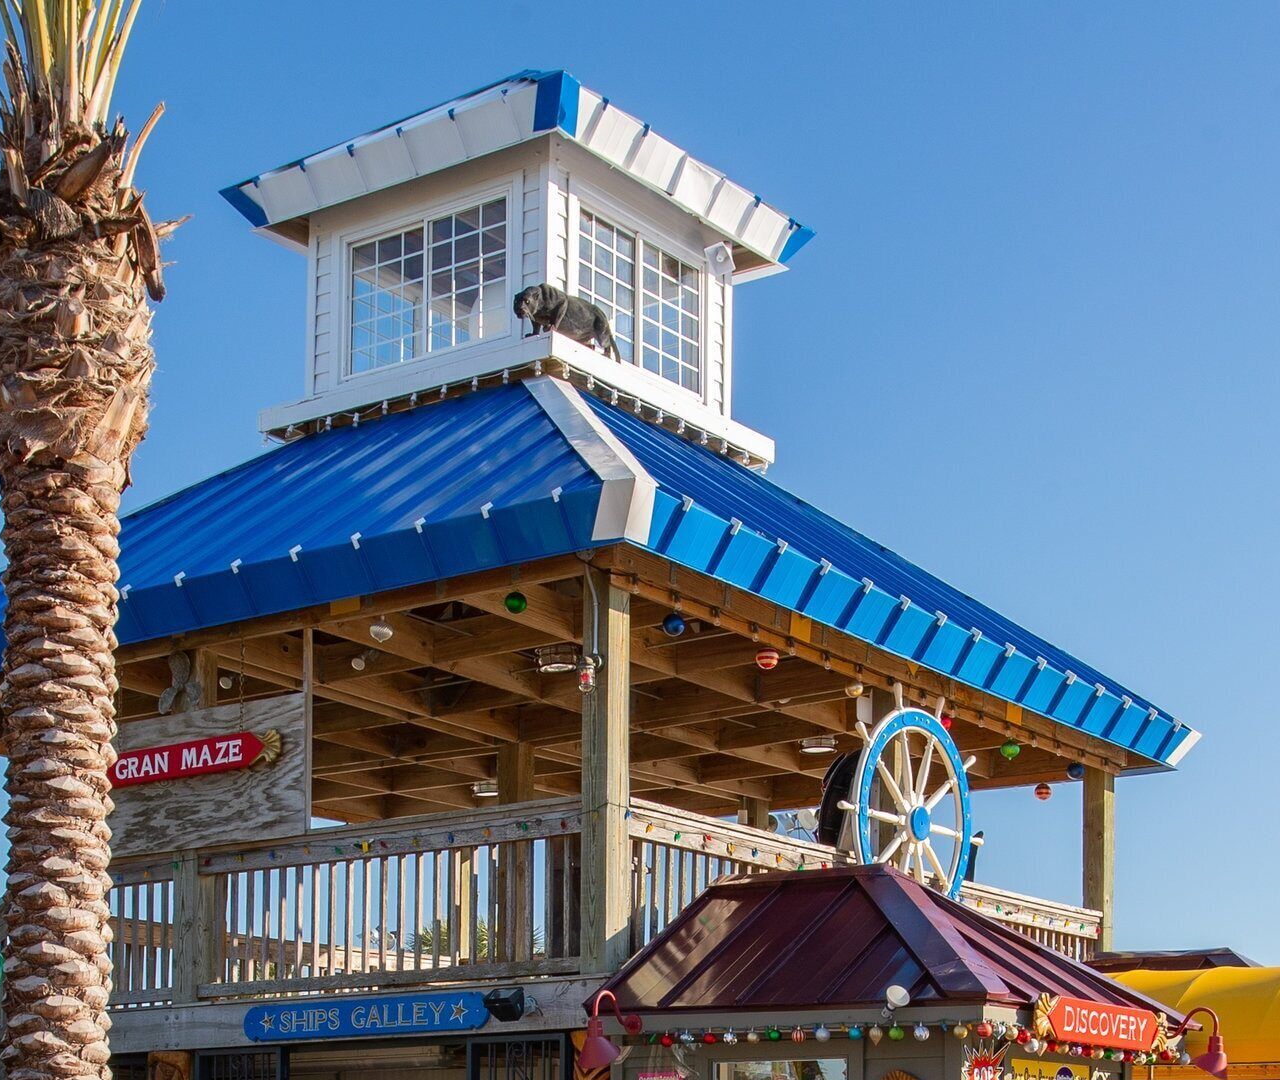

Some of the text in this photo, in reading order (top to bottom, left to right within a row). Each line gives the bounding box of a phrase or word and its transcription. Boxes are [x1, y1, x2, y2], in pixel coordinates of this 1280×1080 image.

[115, 739, 243, 780] GRAN MAZE
[279, 1001, 446, 1033] SHIPS GALLEY
[1063, 1005, 1148, 1042] DISCOVERY
